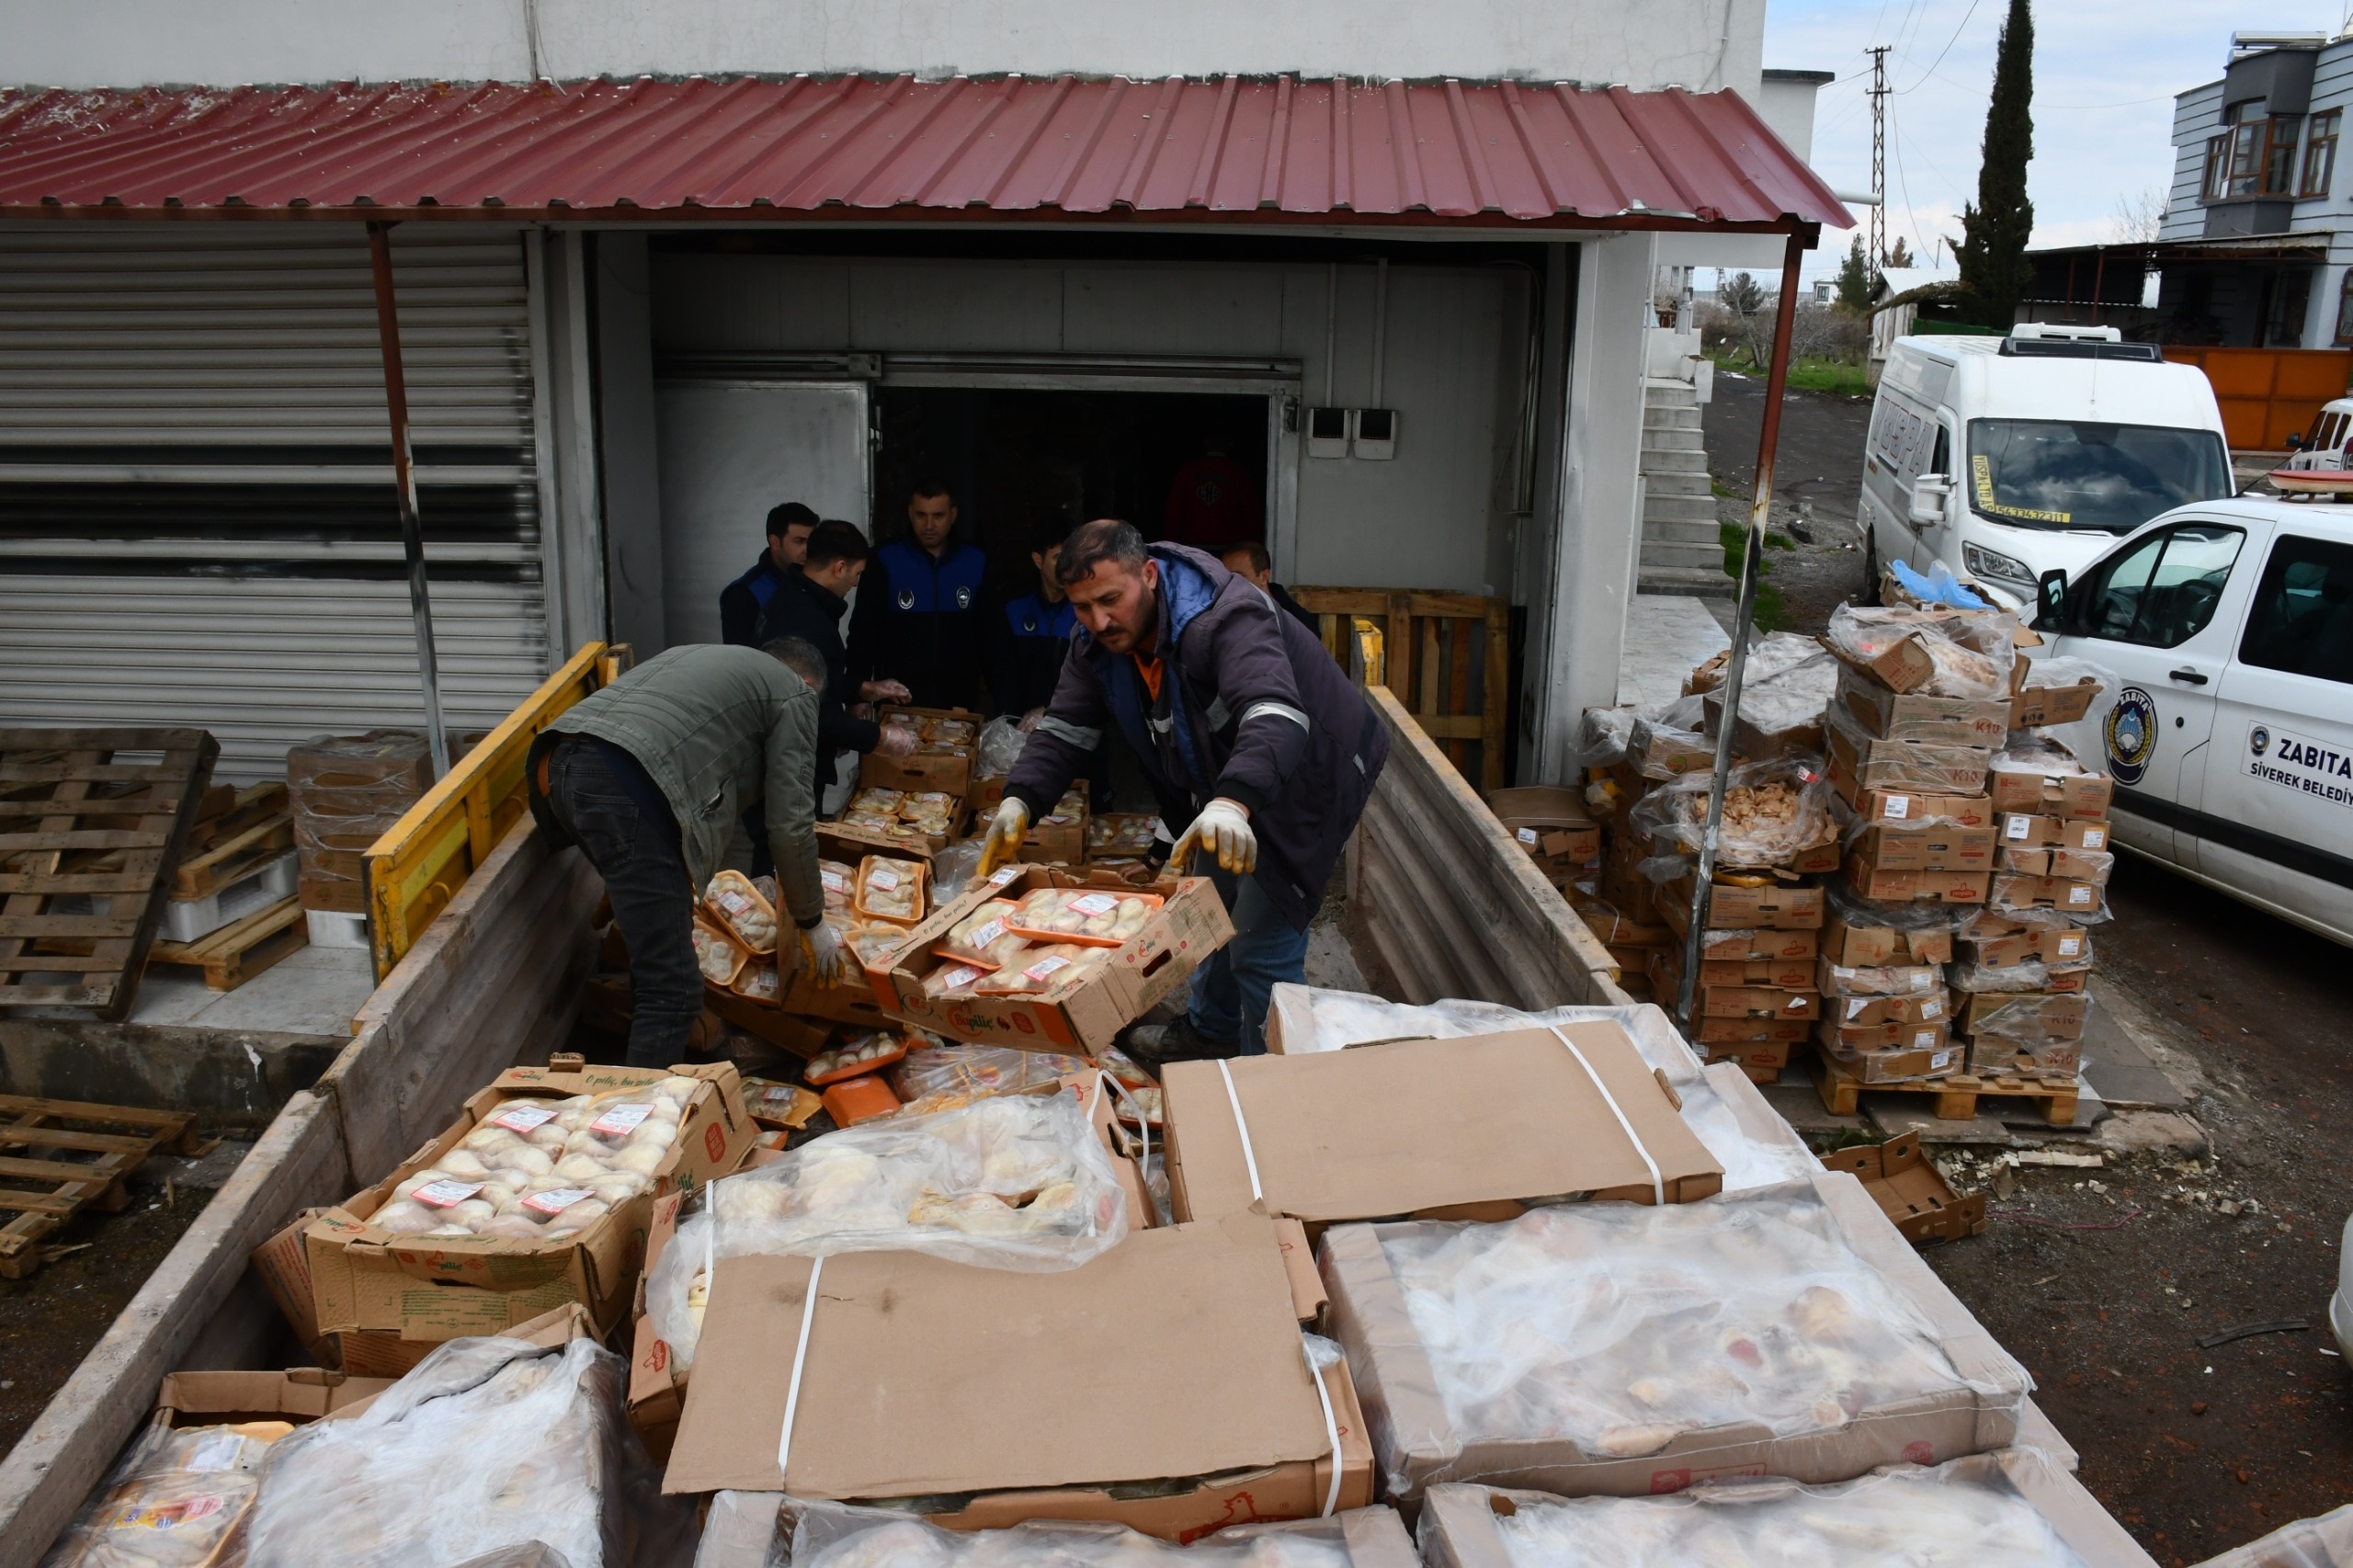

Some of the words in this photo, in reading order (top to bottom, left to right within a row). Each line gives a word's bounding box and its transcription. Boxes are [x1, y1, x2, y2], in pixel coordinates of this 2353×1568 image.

[1973, 457, 1988, 482] YUSPA
[2119, 692, 2149, 711] ZABITA
[2278, 738, 2352, 779] ZABITA
[2250, 762, 2302, 789] SİVEREK
